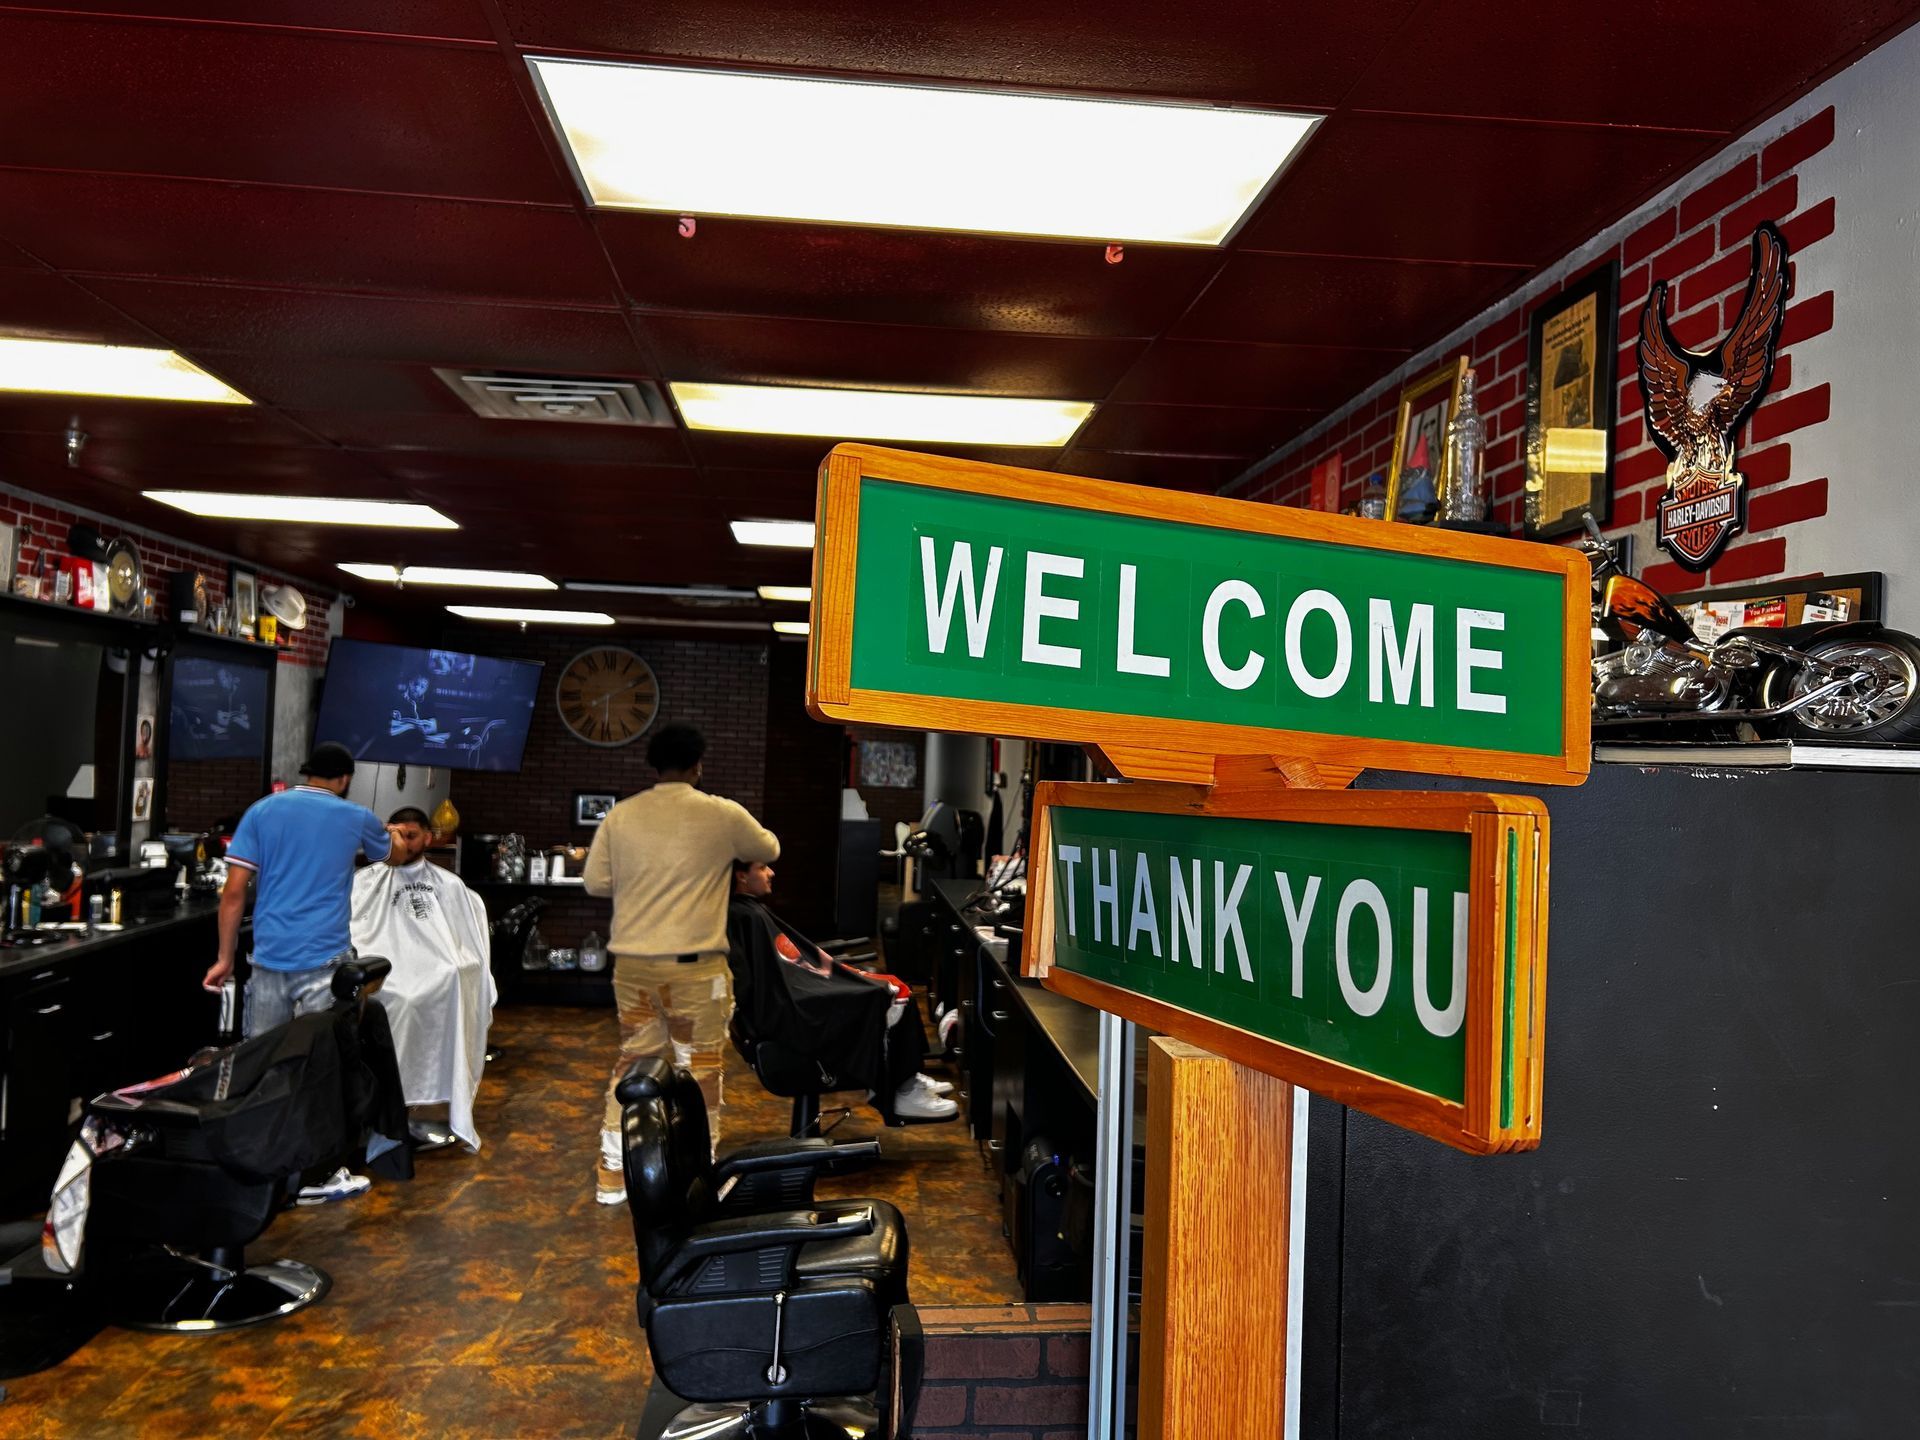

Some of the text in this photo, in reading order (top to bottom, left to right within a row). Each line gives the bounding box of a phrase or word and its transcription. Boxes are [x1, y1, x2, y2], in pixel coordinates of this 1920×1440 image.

[1667, 493, 1731, 529] HARLEY-DAVIDSON
[1680, 523, 1715, 550] CYCLES
[920, 536, 1507, 715] WELCOME
[1058, 844, 1469, 1037] THANK YOU
